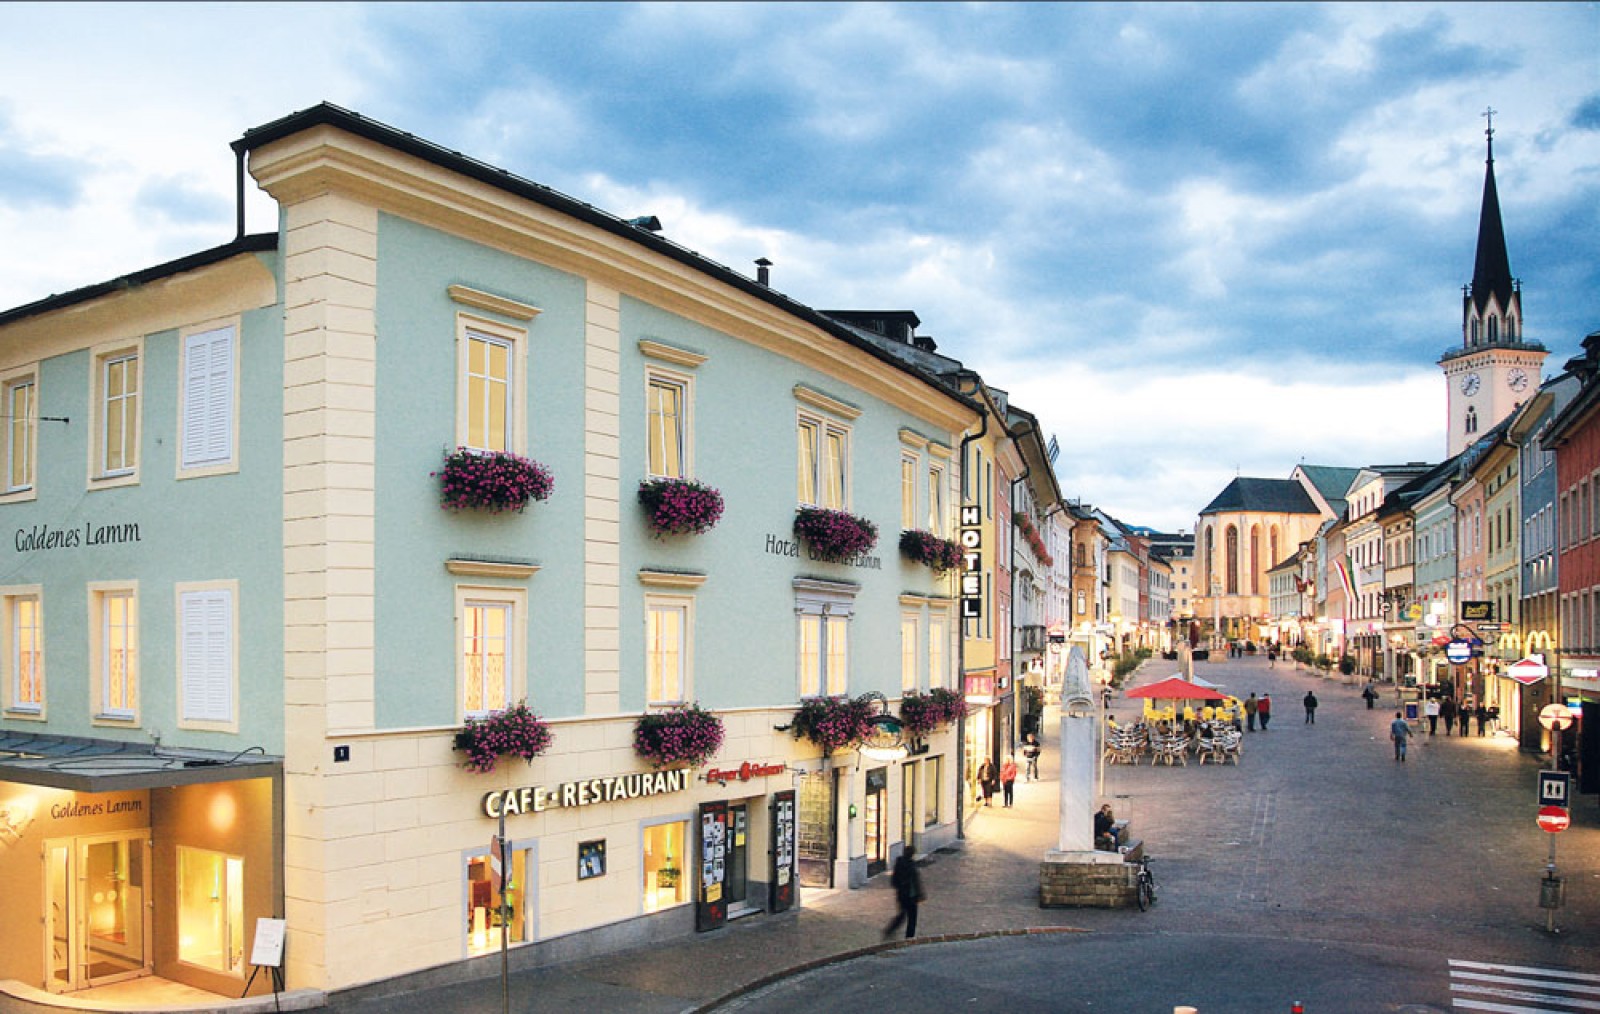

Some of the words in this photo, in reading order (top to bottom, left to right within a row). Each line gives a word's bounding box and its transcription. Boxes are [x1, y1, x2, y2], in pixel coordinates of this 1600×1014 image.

[15, 524, 80, 552] Goldenes
[86, 522, 142, 545] Lamm
[765, 533, 799, 558] Hotel
[962, 507, 980, 616] HOTEL
[484, 786, 546, 819] CAFE
[560, 768, 692, 807] RESTAURANT
[51, 801, 104, 819] Goldenes
[106, 799, 143, 814] Lamm
